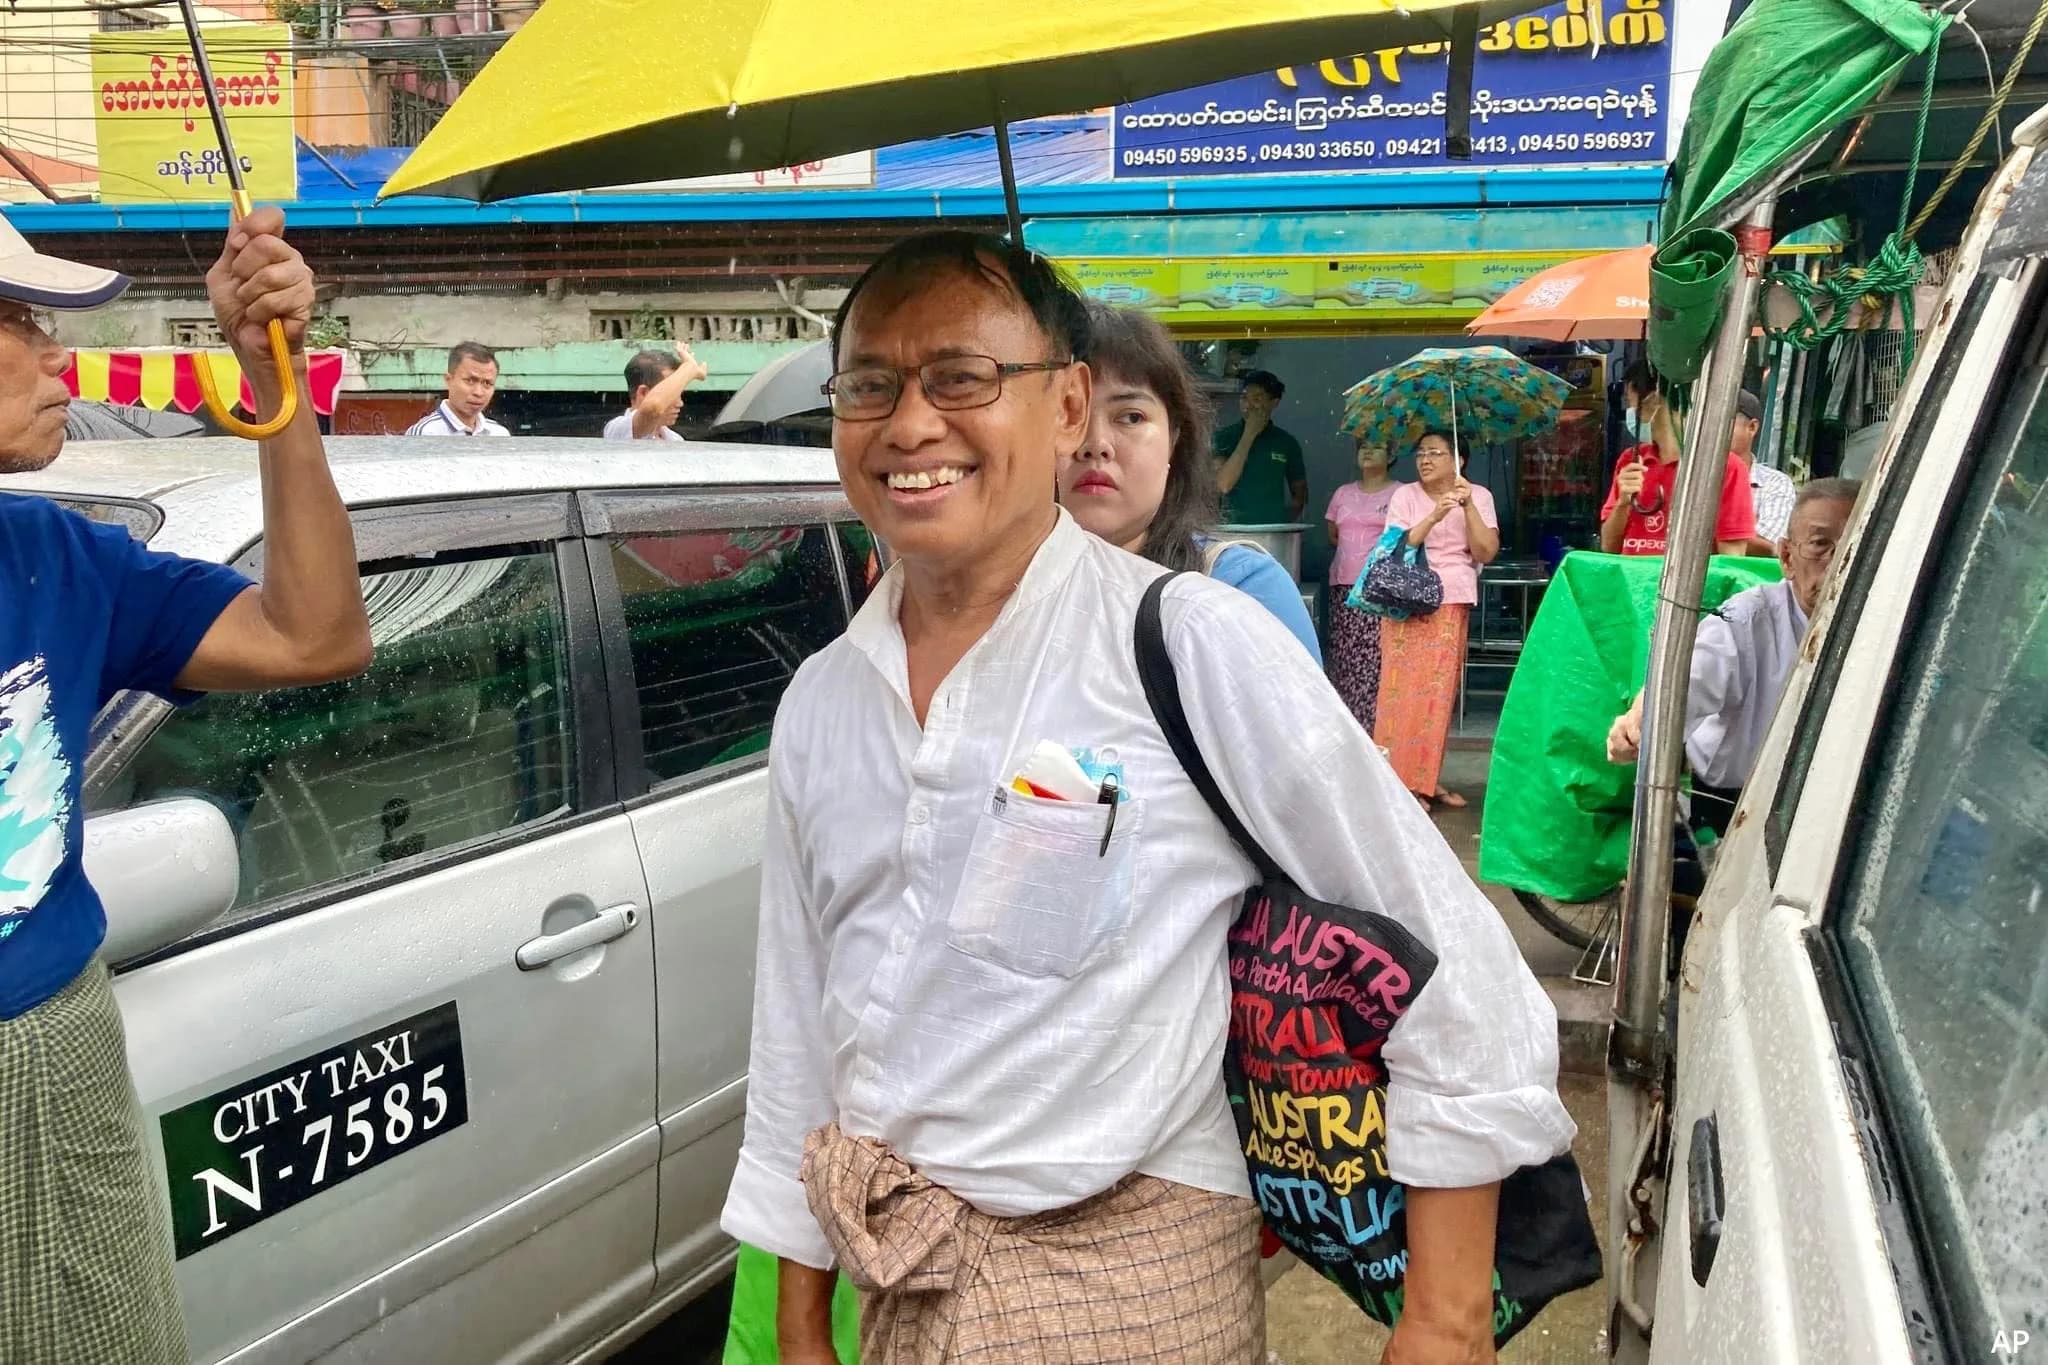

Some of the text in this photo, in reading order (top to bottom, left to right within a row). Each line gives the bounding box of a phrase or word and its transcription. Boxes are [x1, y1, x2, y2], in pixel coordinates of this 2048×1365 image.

[1123, 148, 1177, 166] 09450
[1260, 143, 1315, 161] 09430
[1519, 134, 1579, 152] 09450
[1584, 131, 1656, 150] 596937
[1615, 295, 1649, 308] Sh
[213, 1031, 415, 1144] CITY TAXI
[1249, 1083, 1387, 1149] AUSTRA
[192, 1063, 449, 1238] N-7585
